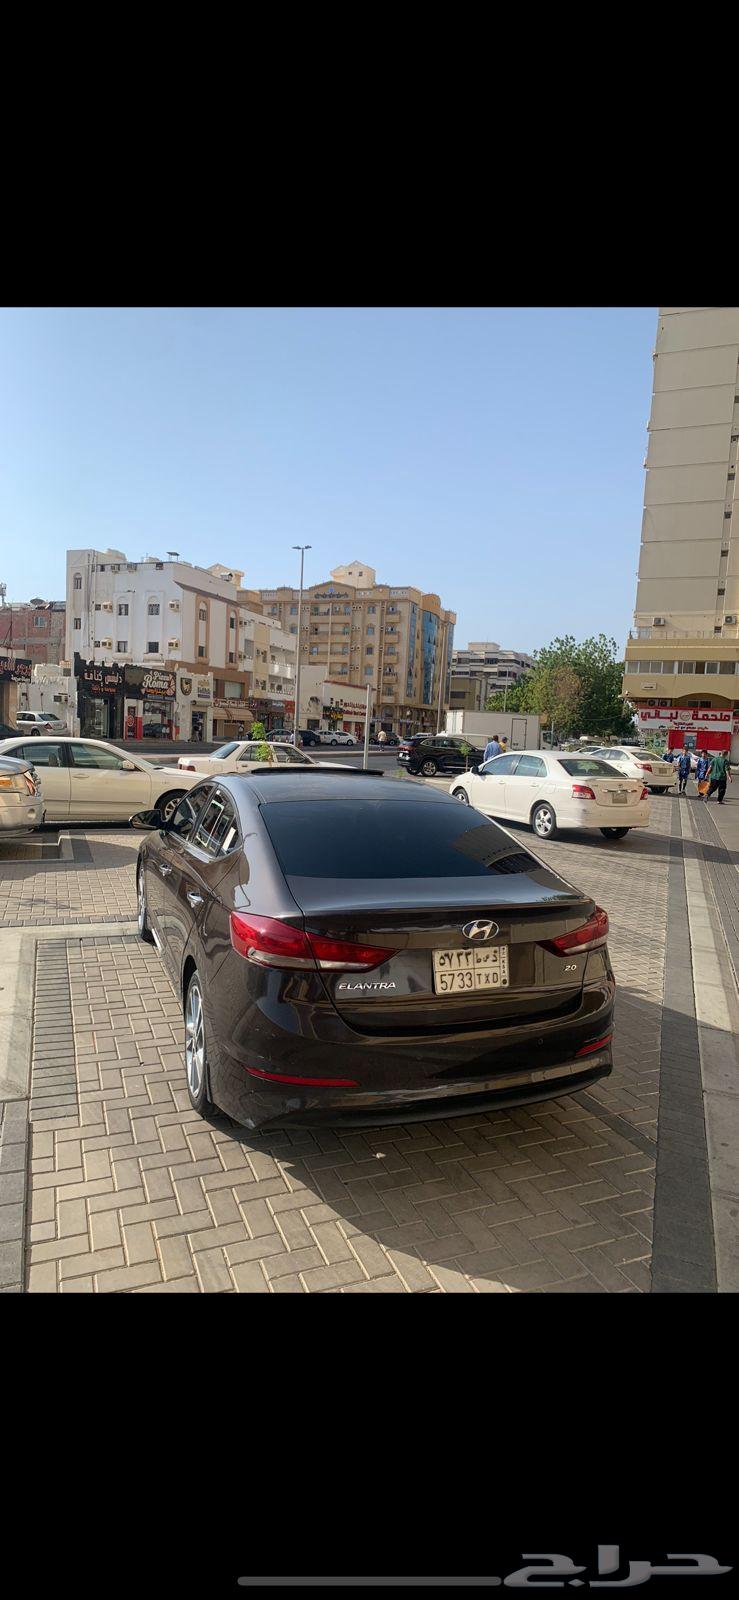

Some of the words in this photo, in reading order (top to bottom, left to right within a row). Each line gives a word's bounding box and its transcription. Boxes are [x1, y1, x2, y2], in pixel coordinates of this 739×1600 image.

[142, 674, 169, 689] Roma
[692, 710, 731, 721] ملحمة
[338, 982, 396, 990] ELANTRA
[440, 972, 473, 991] 5733
